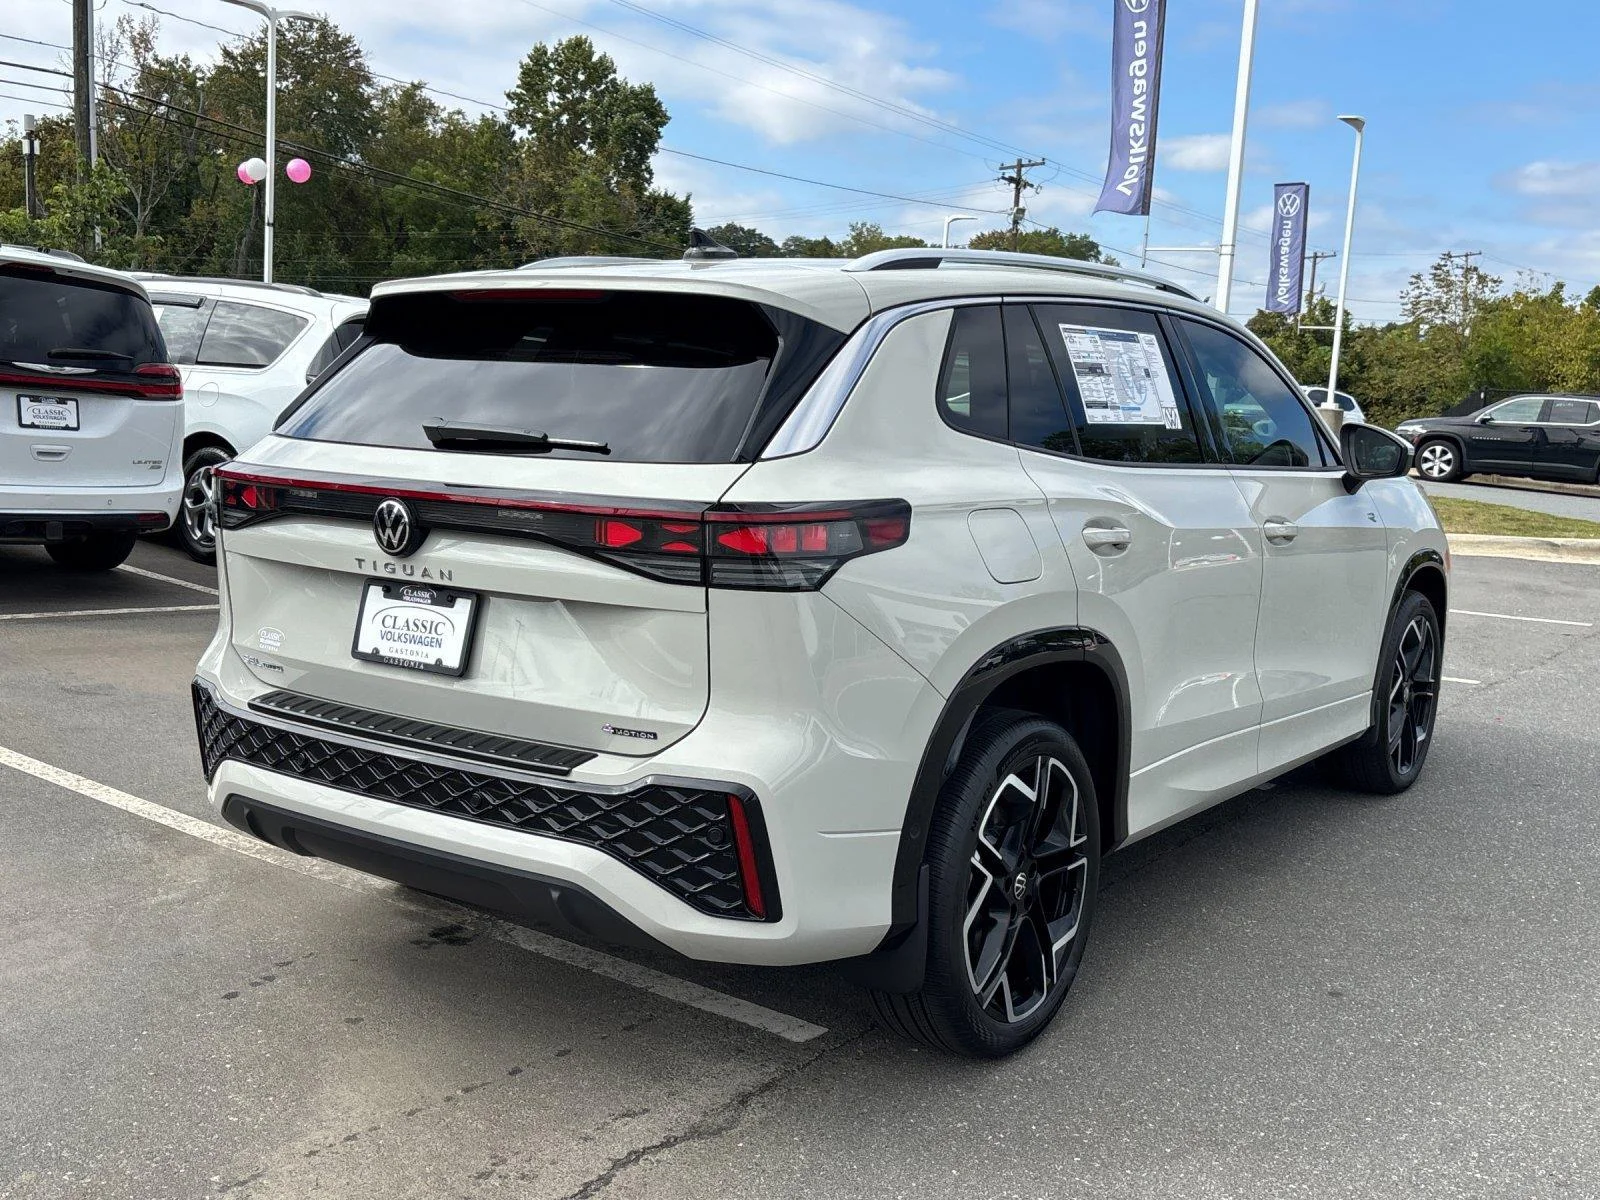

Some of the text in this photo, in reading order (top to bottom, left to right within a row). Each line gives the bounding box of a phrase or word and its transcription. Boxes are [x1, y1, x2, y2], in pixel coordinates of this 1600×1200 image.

[32, 408, 67, 416] CLASSIC
[355, 558, 453, 581] TIGUAN
[403, 588, 433, 599] CLASSIC
[382, 614, 446, 636] CLASSIC
[380, 630, 443, 649] VOLKSWAGEN
[388, 647, 430, 659] GASTONIA
[383, 657, 425, 670] GASTONIA
